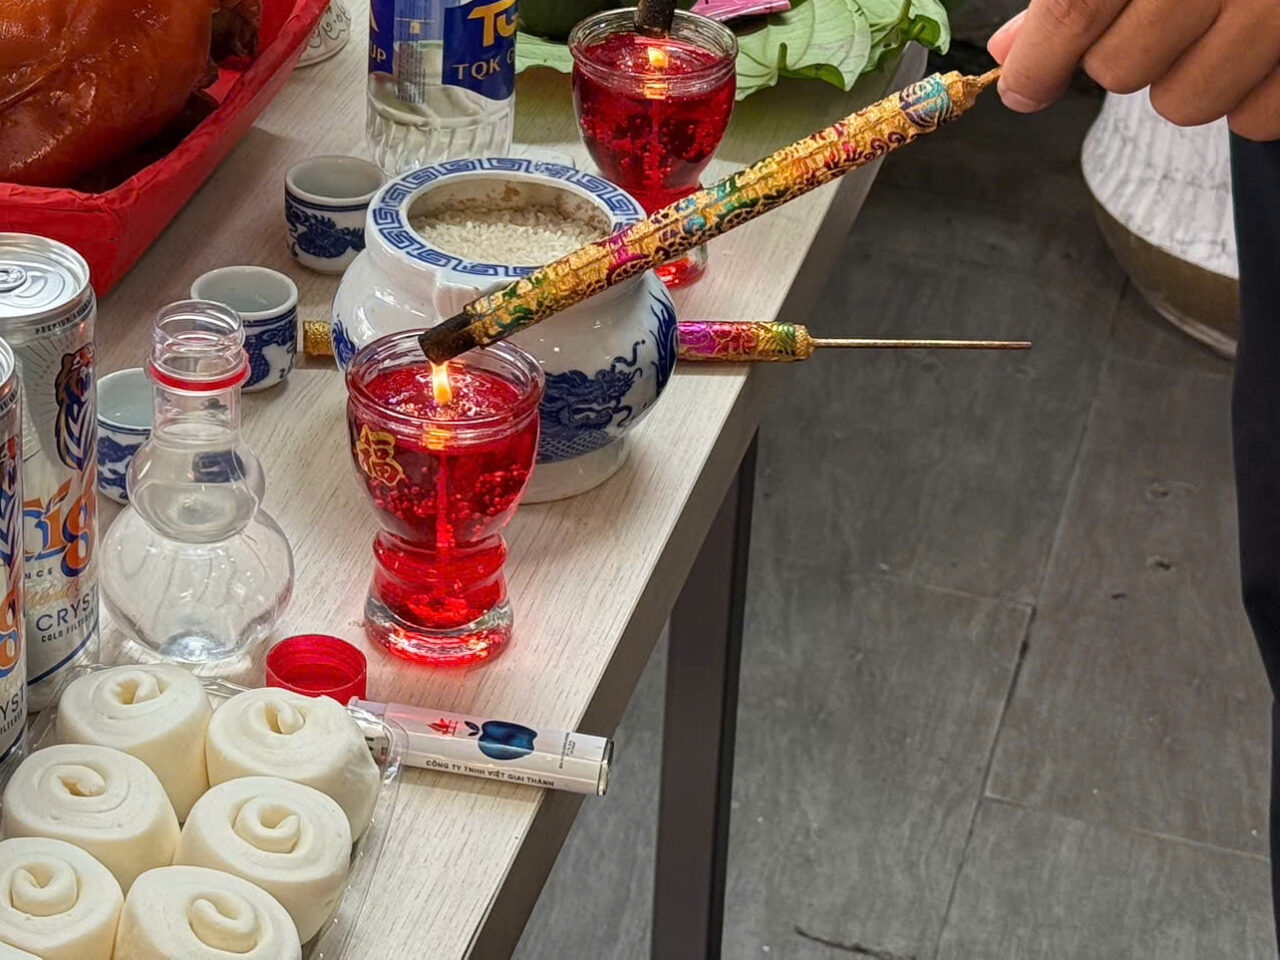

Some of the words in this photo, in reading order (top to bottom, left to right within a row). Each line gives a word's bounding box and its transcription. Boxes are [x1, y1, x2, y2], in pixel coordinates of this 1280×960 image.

[452, 55, 500, 80] TQK
[355, 424, 405, 487] 福
[425, 759, 449, 770] CÔNG
[452, 764, 463, 772] TY
[464, 766, 486, 777] TNHH
